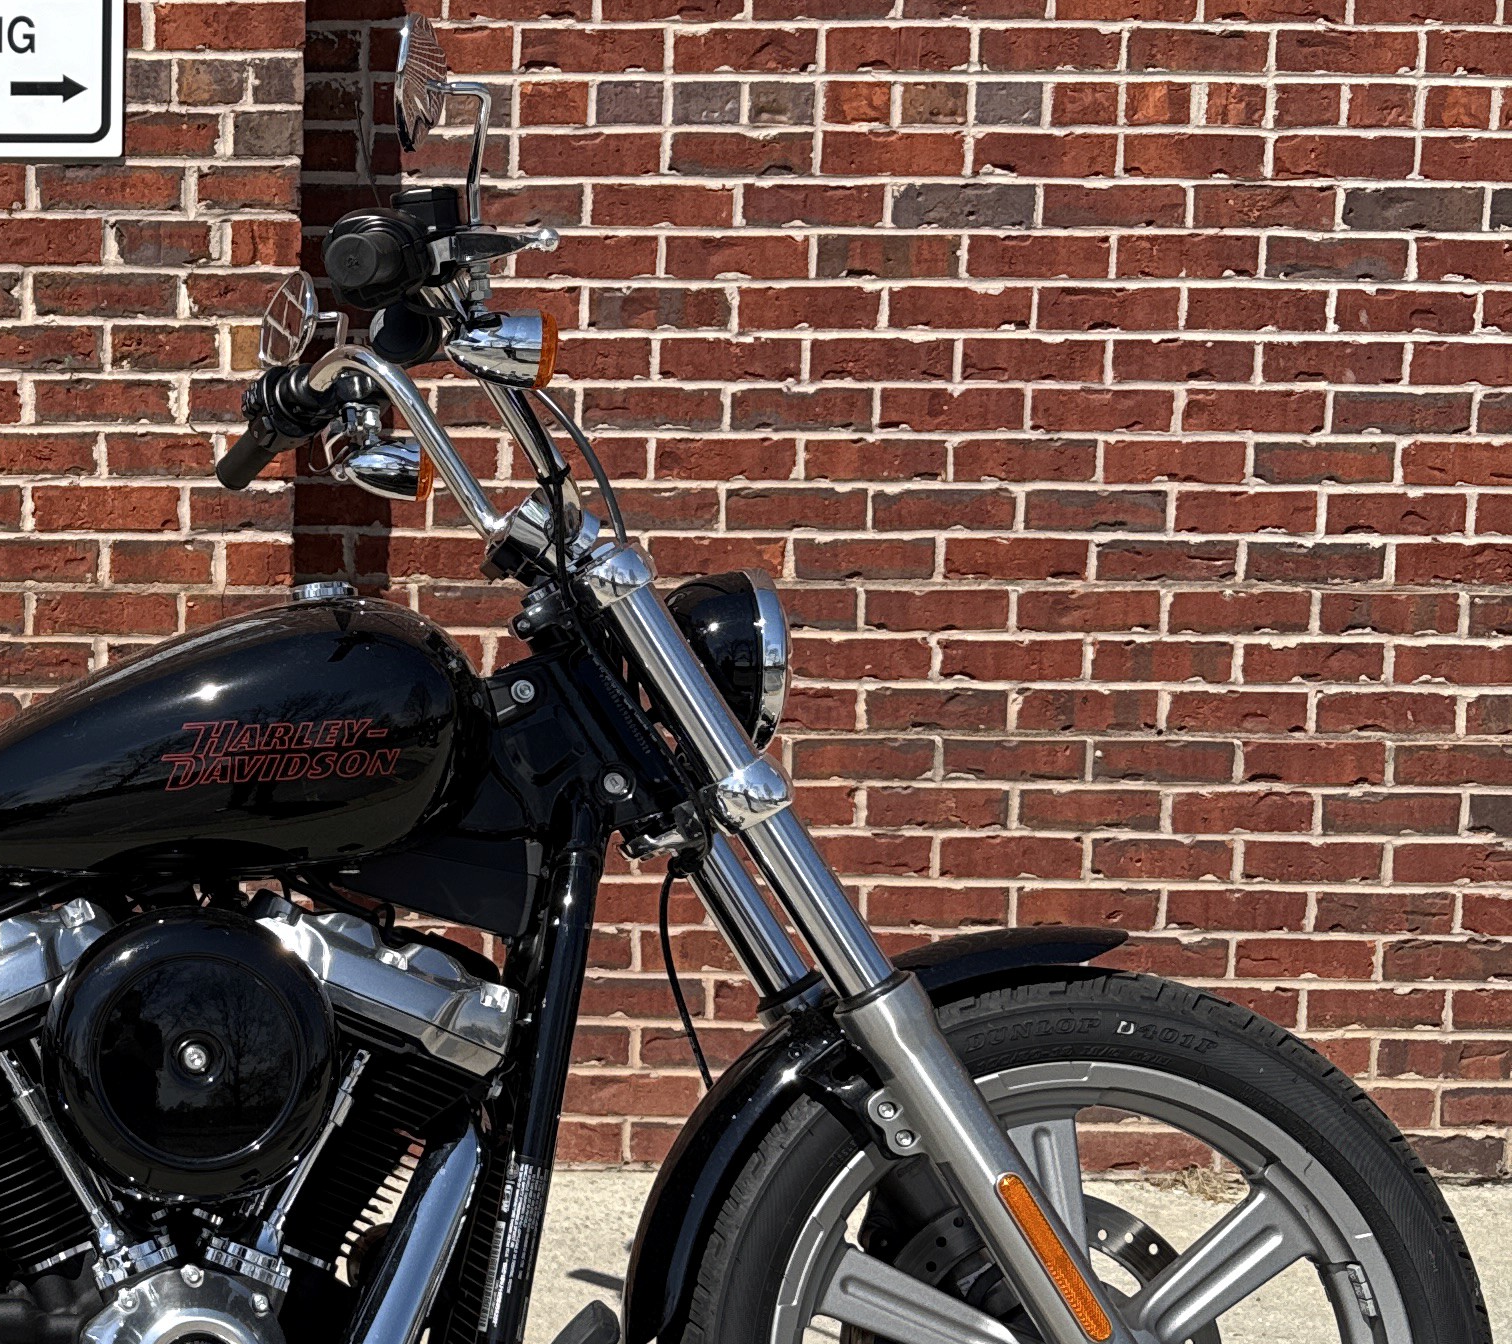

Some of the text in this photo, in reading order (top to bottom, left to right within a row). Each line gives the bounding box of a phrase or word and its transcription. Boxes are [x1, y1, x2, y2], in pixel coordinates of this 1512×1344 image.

[181, 718, 389, 757] HARLEY-
[161, 748, 402, 792] DAVIDSON
[963, 1016, 1101, 1053] DUNLOP
